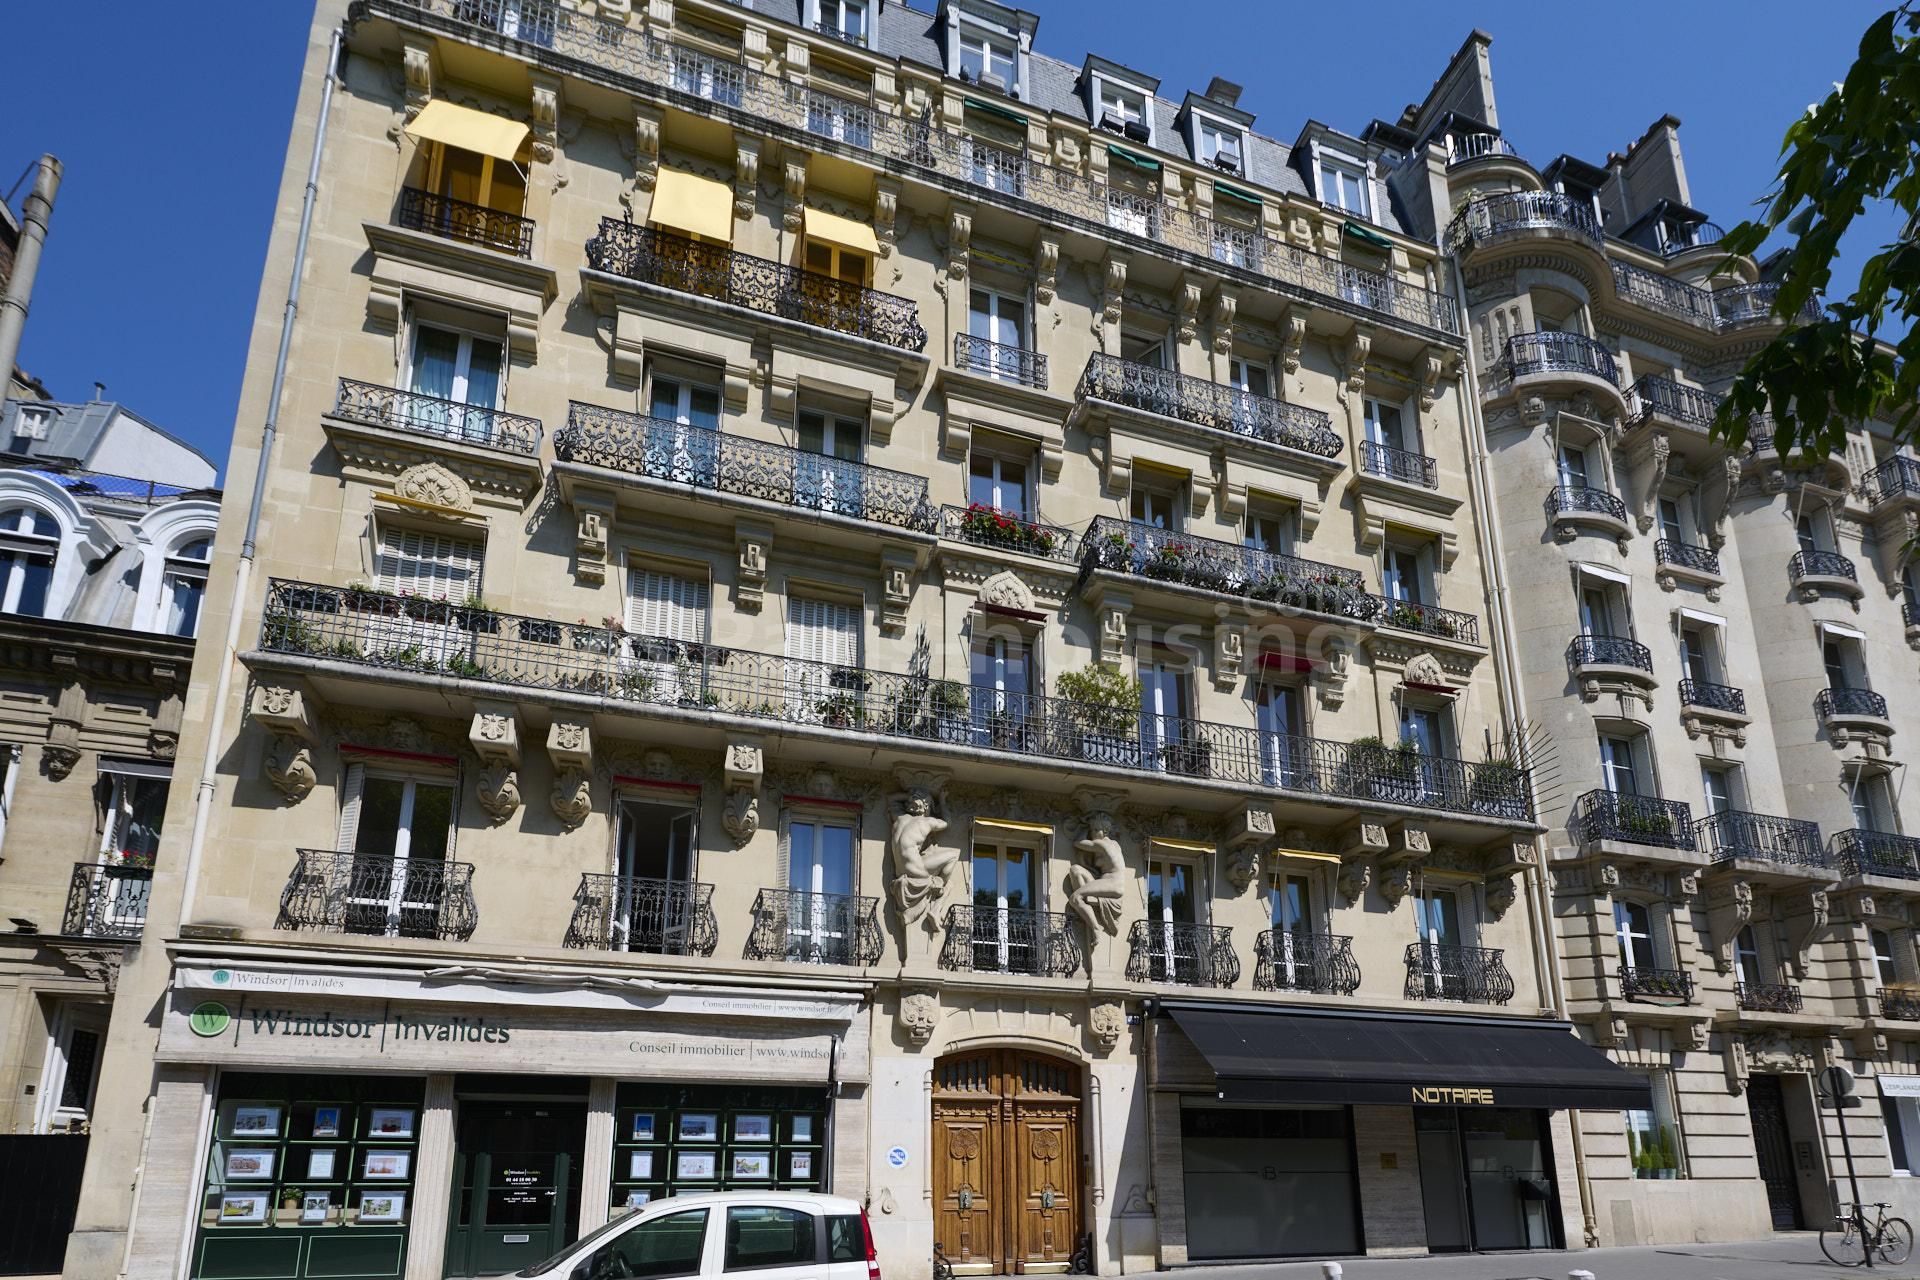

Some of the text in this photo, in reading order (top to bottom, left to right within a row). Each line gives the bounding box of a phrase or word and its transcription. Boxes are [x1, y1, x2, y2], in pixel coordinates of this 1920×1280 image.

[236, 973, 289, 986] Windsor
[293, 976, 345, 988] Invalides
[702, 1000, 731, 1009] Conseil
[732, 1001, 772, 1011] immobilier
[250, 1009, 376, 1039] Windsor
[394, 1015, 511, 1044] Invalides
[629, 1041, 676, 1055] Conseil
[679, 1042, 746, 1057] immobilier
[1411, 1086, 1495, 1105] NOTAIRE
